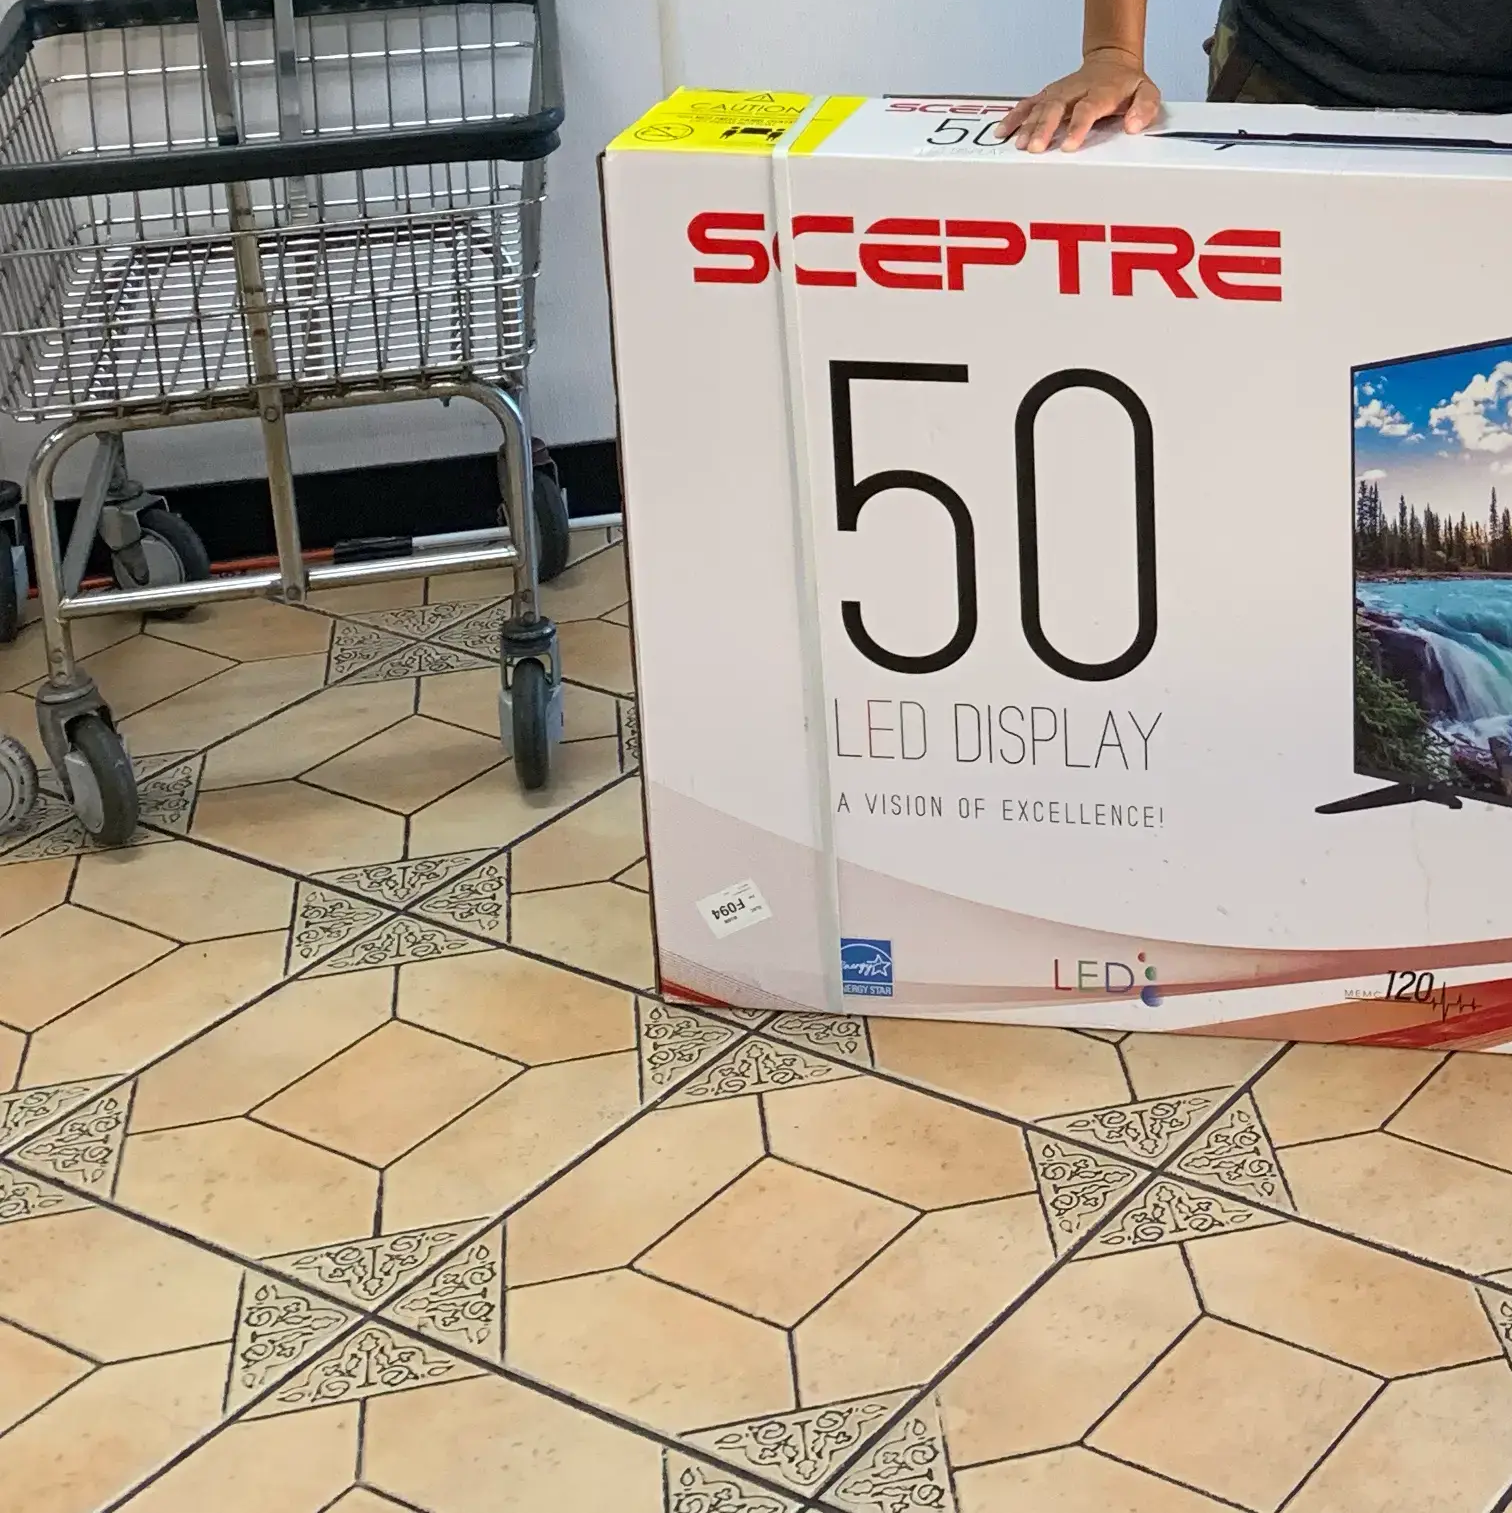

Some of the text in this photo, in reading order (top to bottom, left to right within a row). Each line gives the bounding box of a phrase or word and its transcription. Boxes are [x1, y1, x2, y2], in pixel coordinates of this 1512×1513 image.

[690, 103, 806, 113] CAUTION
[885, 103, 1016, 114] SCEP
[927, 118, 1016, 146] 50
[686, 211, 1282, 302] SCEPTRE
[829, 360, 1159, 683] 50
[833, 697, 1163, 772] LED DISPLAY
[837, 792, 1166, 830] A VISION OF EXCELLENCE!
[712, 898, 745, 920] F094
[870, 986, 891, 995] STAR
[1054, 959, 1134, 993] LED
[1384, 970, 1435, 1002] 120
